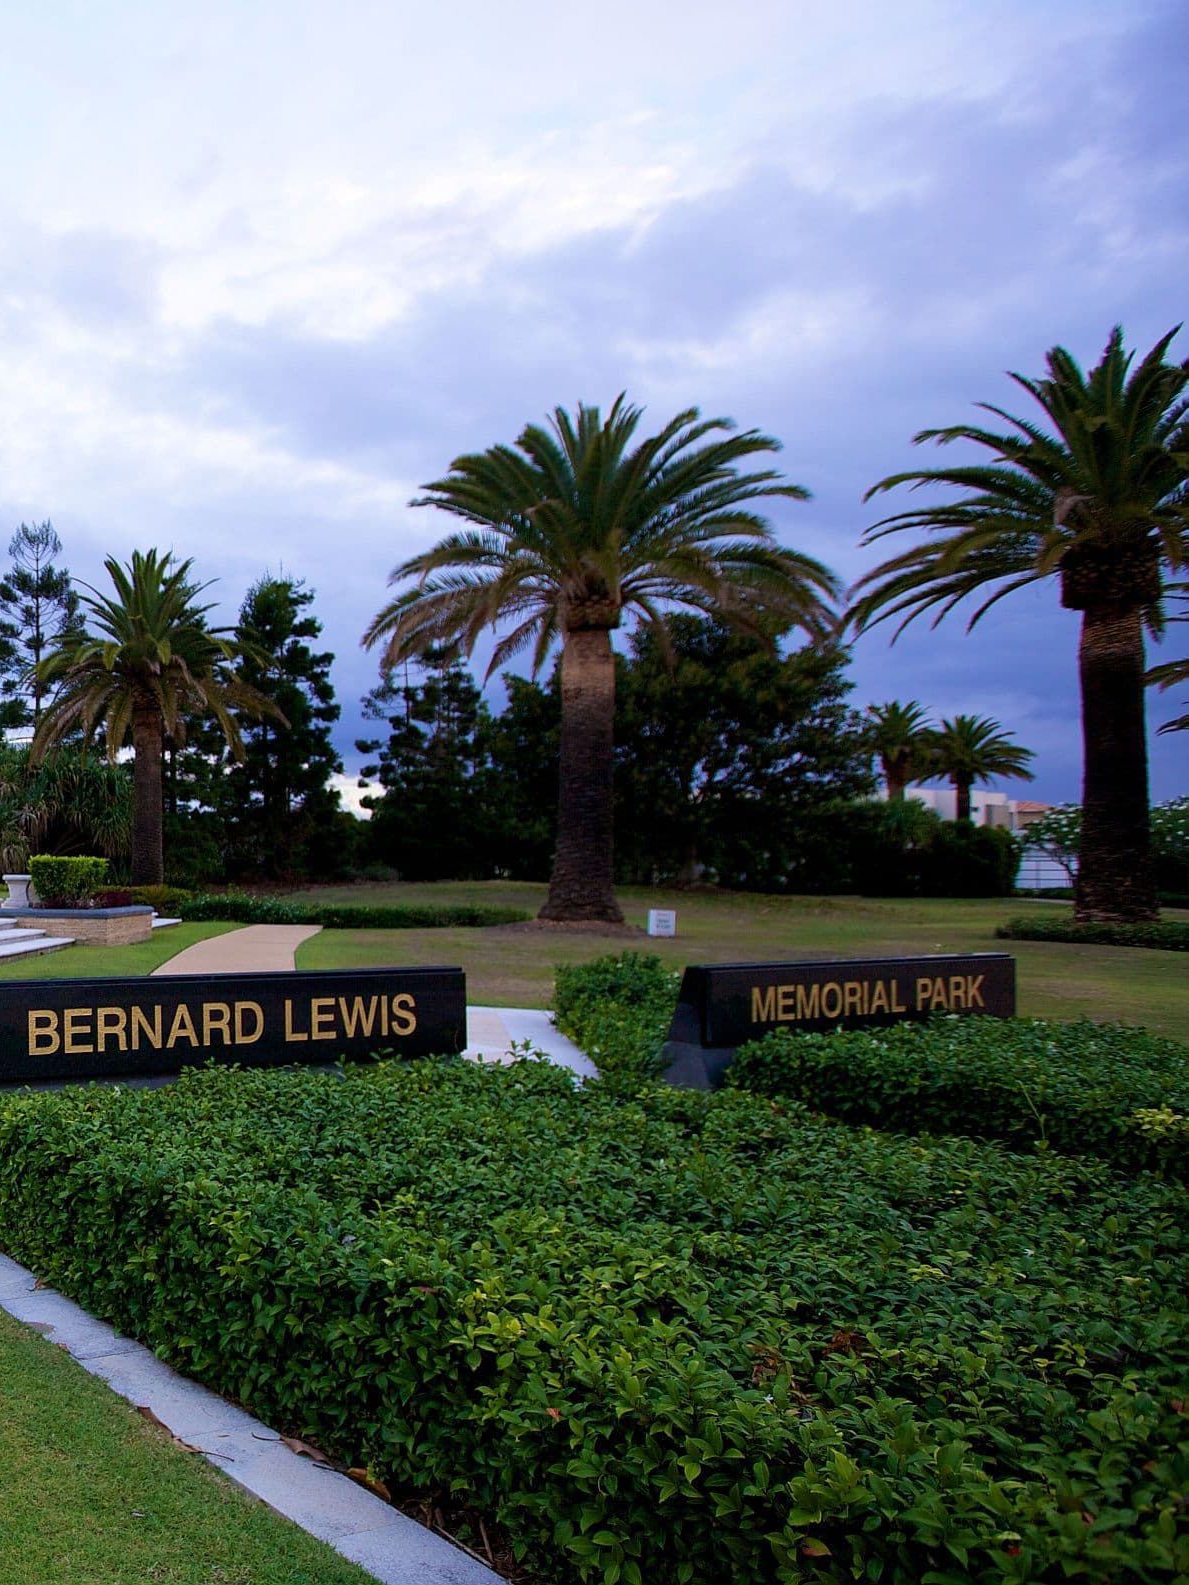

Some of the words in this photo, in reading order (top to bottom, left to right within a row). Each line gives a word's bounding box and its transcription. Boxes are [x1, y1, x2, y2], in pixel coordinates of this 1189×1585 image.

[27, 1001, 264, 1056] BERNARD
[284, 993, 417, 1042] LEWIS
[751, 979, 906, 1022] MEMORIAL
[916, 975, 985, 1010] PARK
